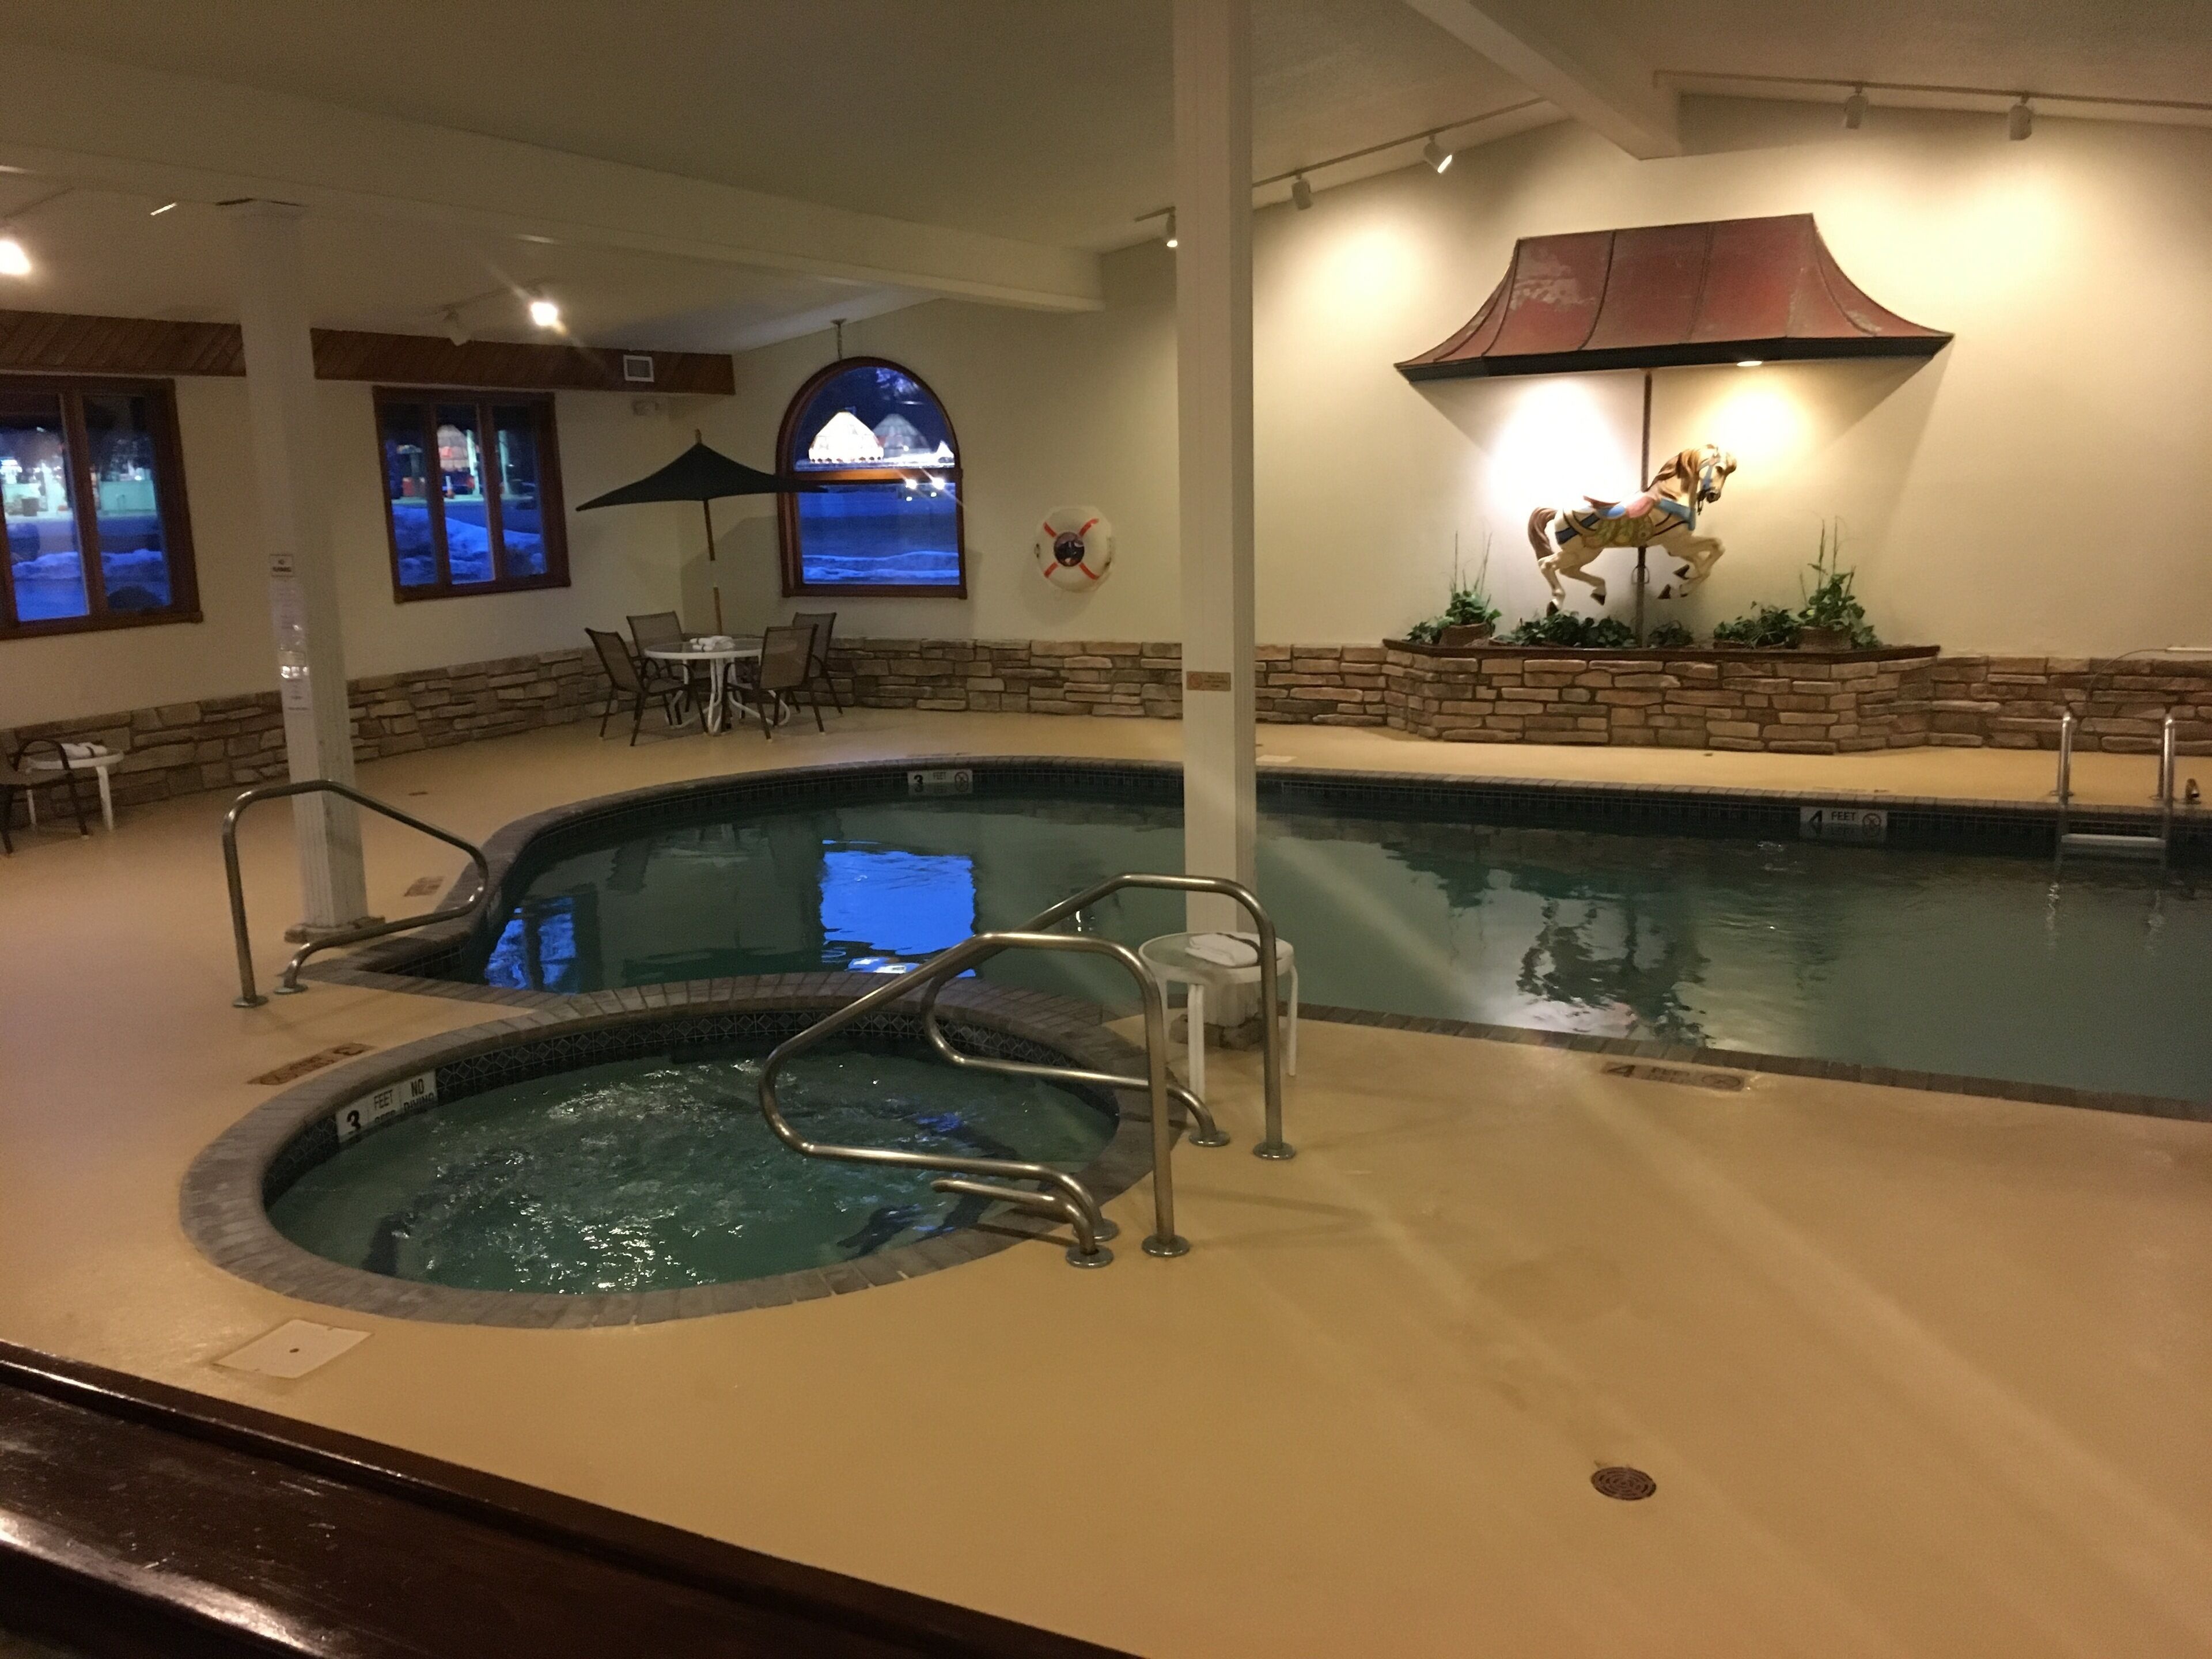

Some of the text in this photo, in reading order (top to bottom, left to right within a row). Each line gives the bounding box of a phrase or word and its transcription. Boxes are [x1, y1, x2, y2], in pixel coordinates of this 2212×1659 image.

[1809, 809, 1857, 823] 4 FEET
[1607, 1065, 1636, 1078] 4
[411, 1078, 425, 1097] NO
[373, 1089, 393, 1111] FEET
